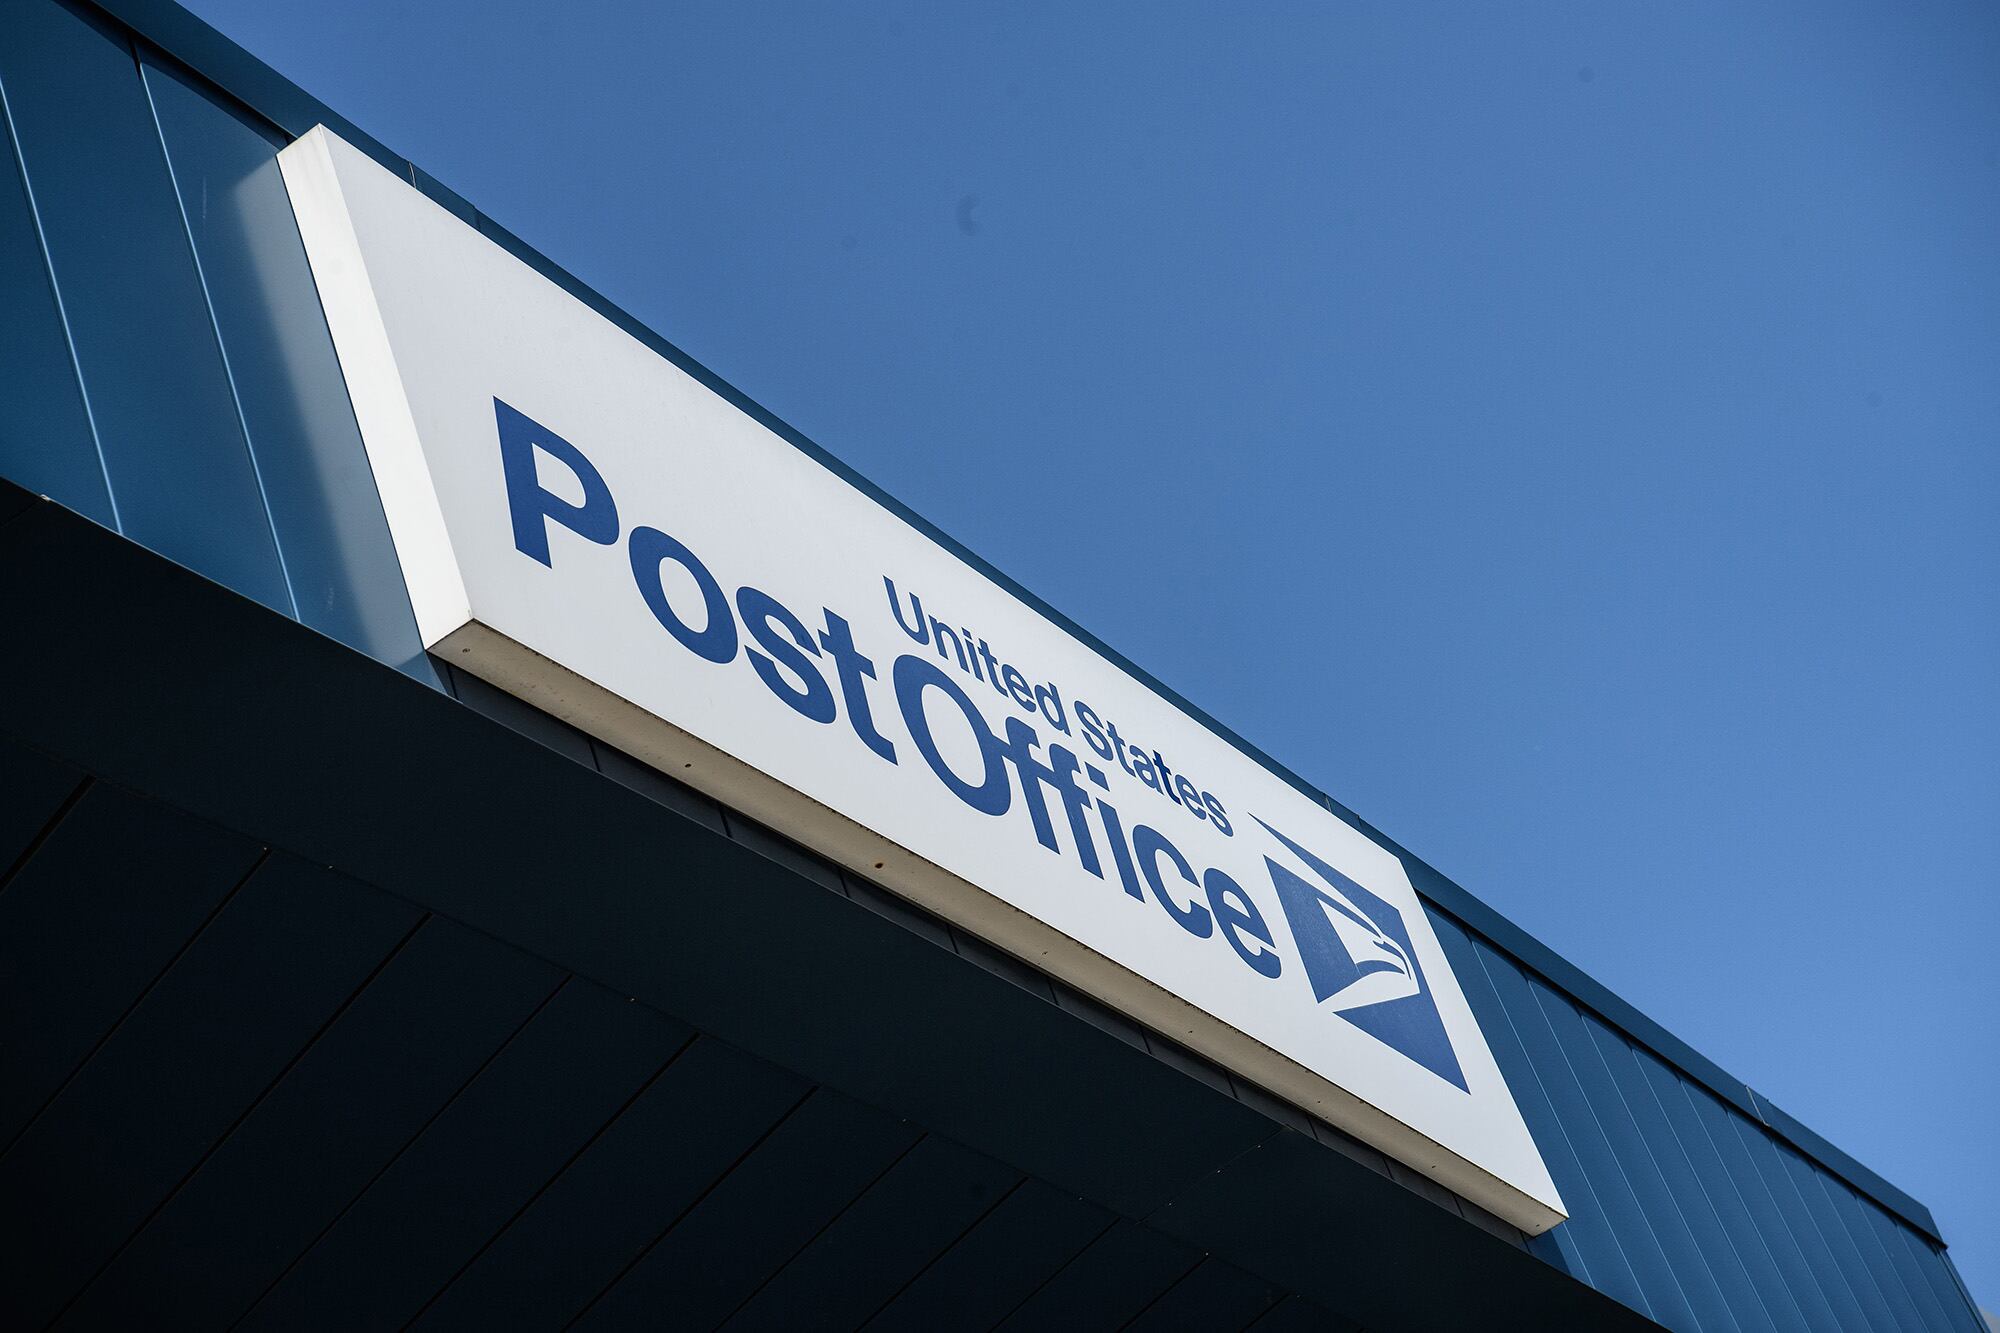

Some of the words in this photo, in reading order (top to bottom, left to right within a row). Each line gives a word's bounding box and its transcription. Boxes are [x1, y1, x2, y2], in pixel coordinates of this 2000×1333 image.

[493, 395, 899, 767] Post
[892, 654, 1282, 981] Office
[883, 574, 1072, 738] United
[1073, 700, 1234, 838] States
